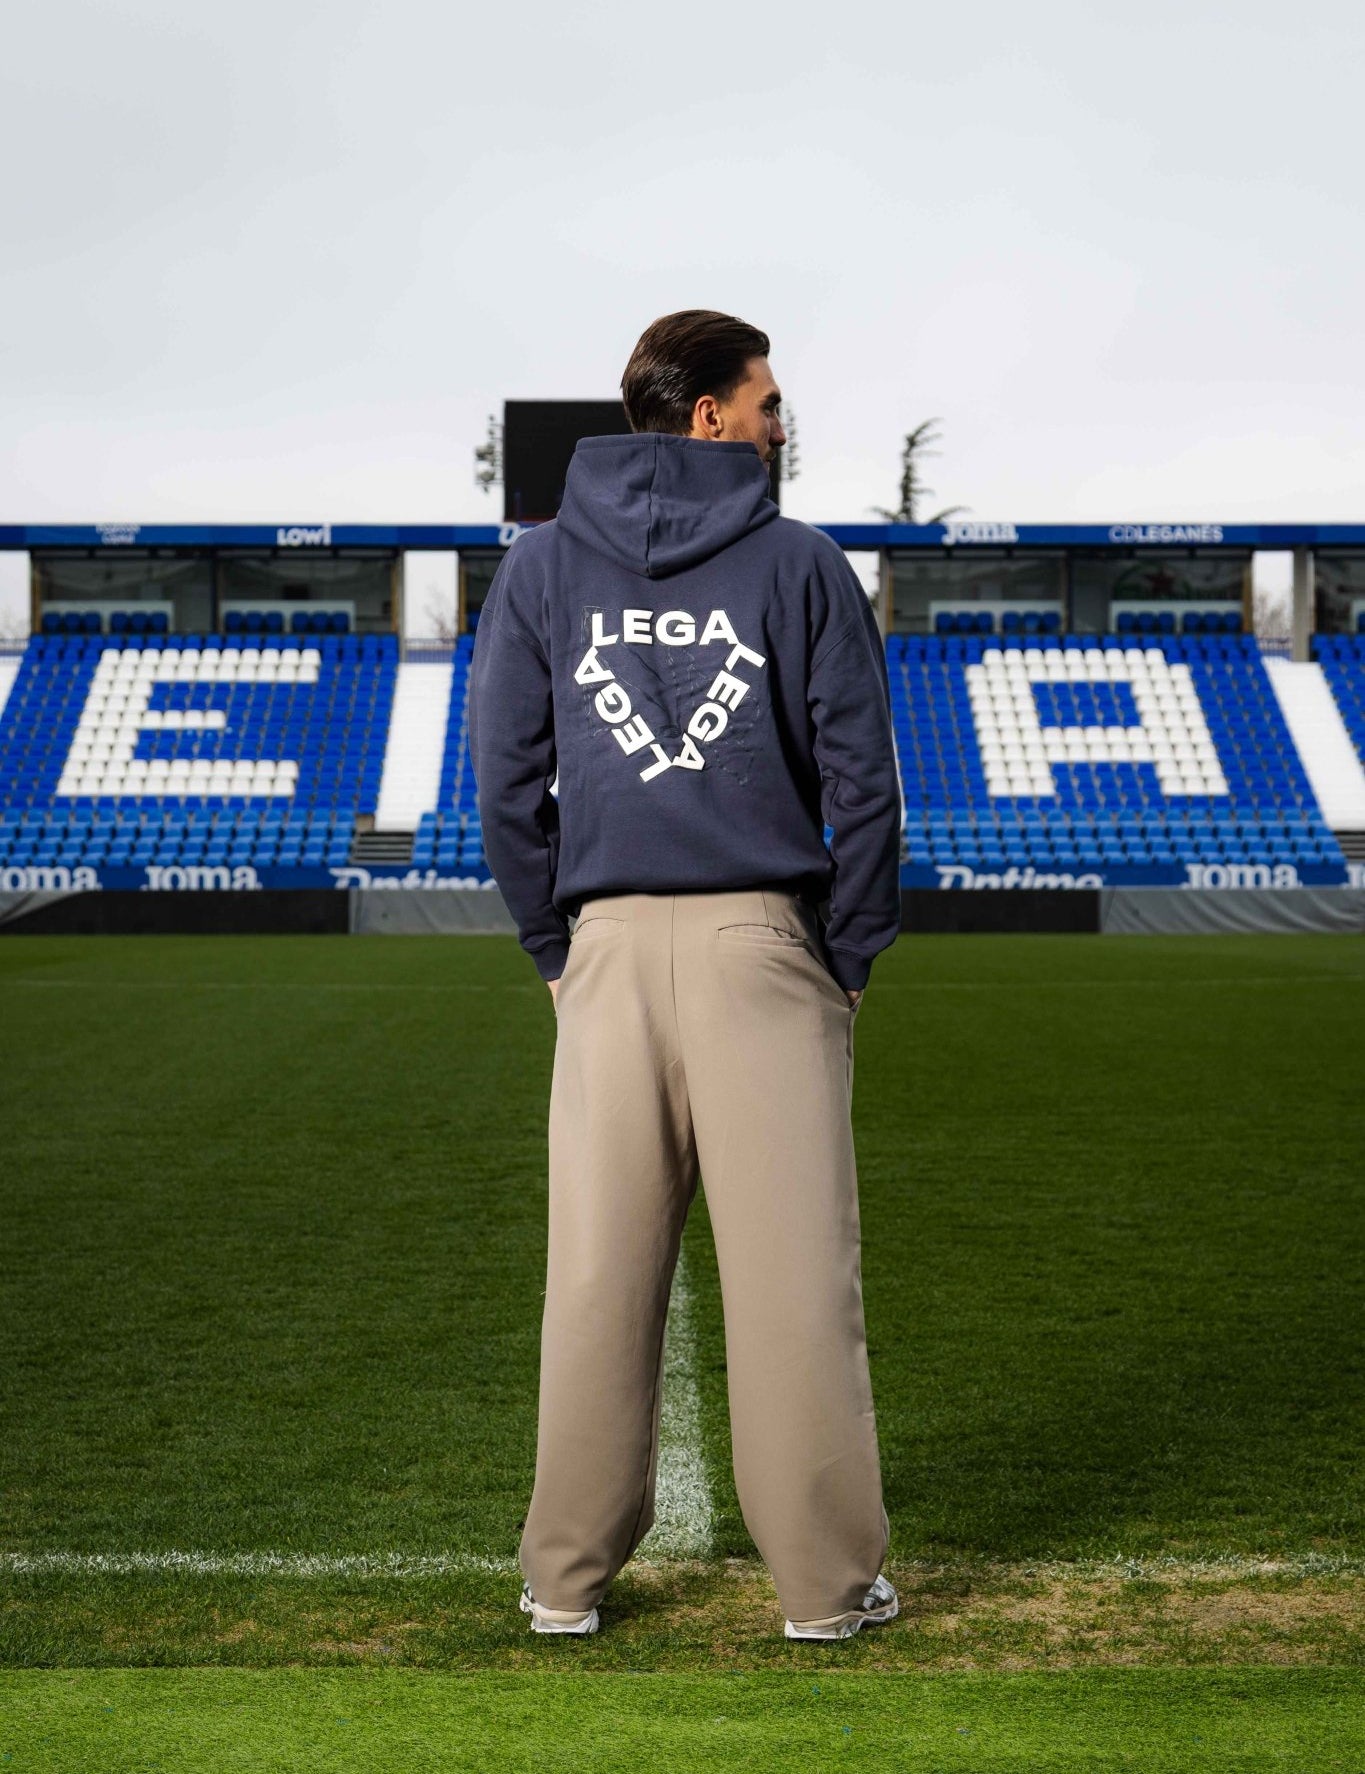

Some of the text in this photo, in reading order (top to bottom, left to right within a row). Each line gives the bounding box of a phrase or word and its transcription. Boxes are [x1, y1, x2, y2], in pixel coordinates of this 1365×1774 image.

[592, 609, 738, 647] LEGA
[56, 648, 321, 796] E
[574, 646, 675, 782] LEGA
[672, 642, 767, 771] LEGA
[0, 866, 99, 891] oma
